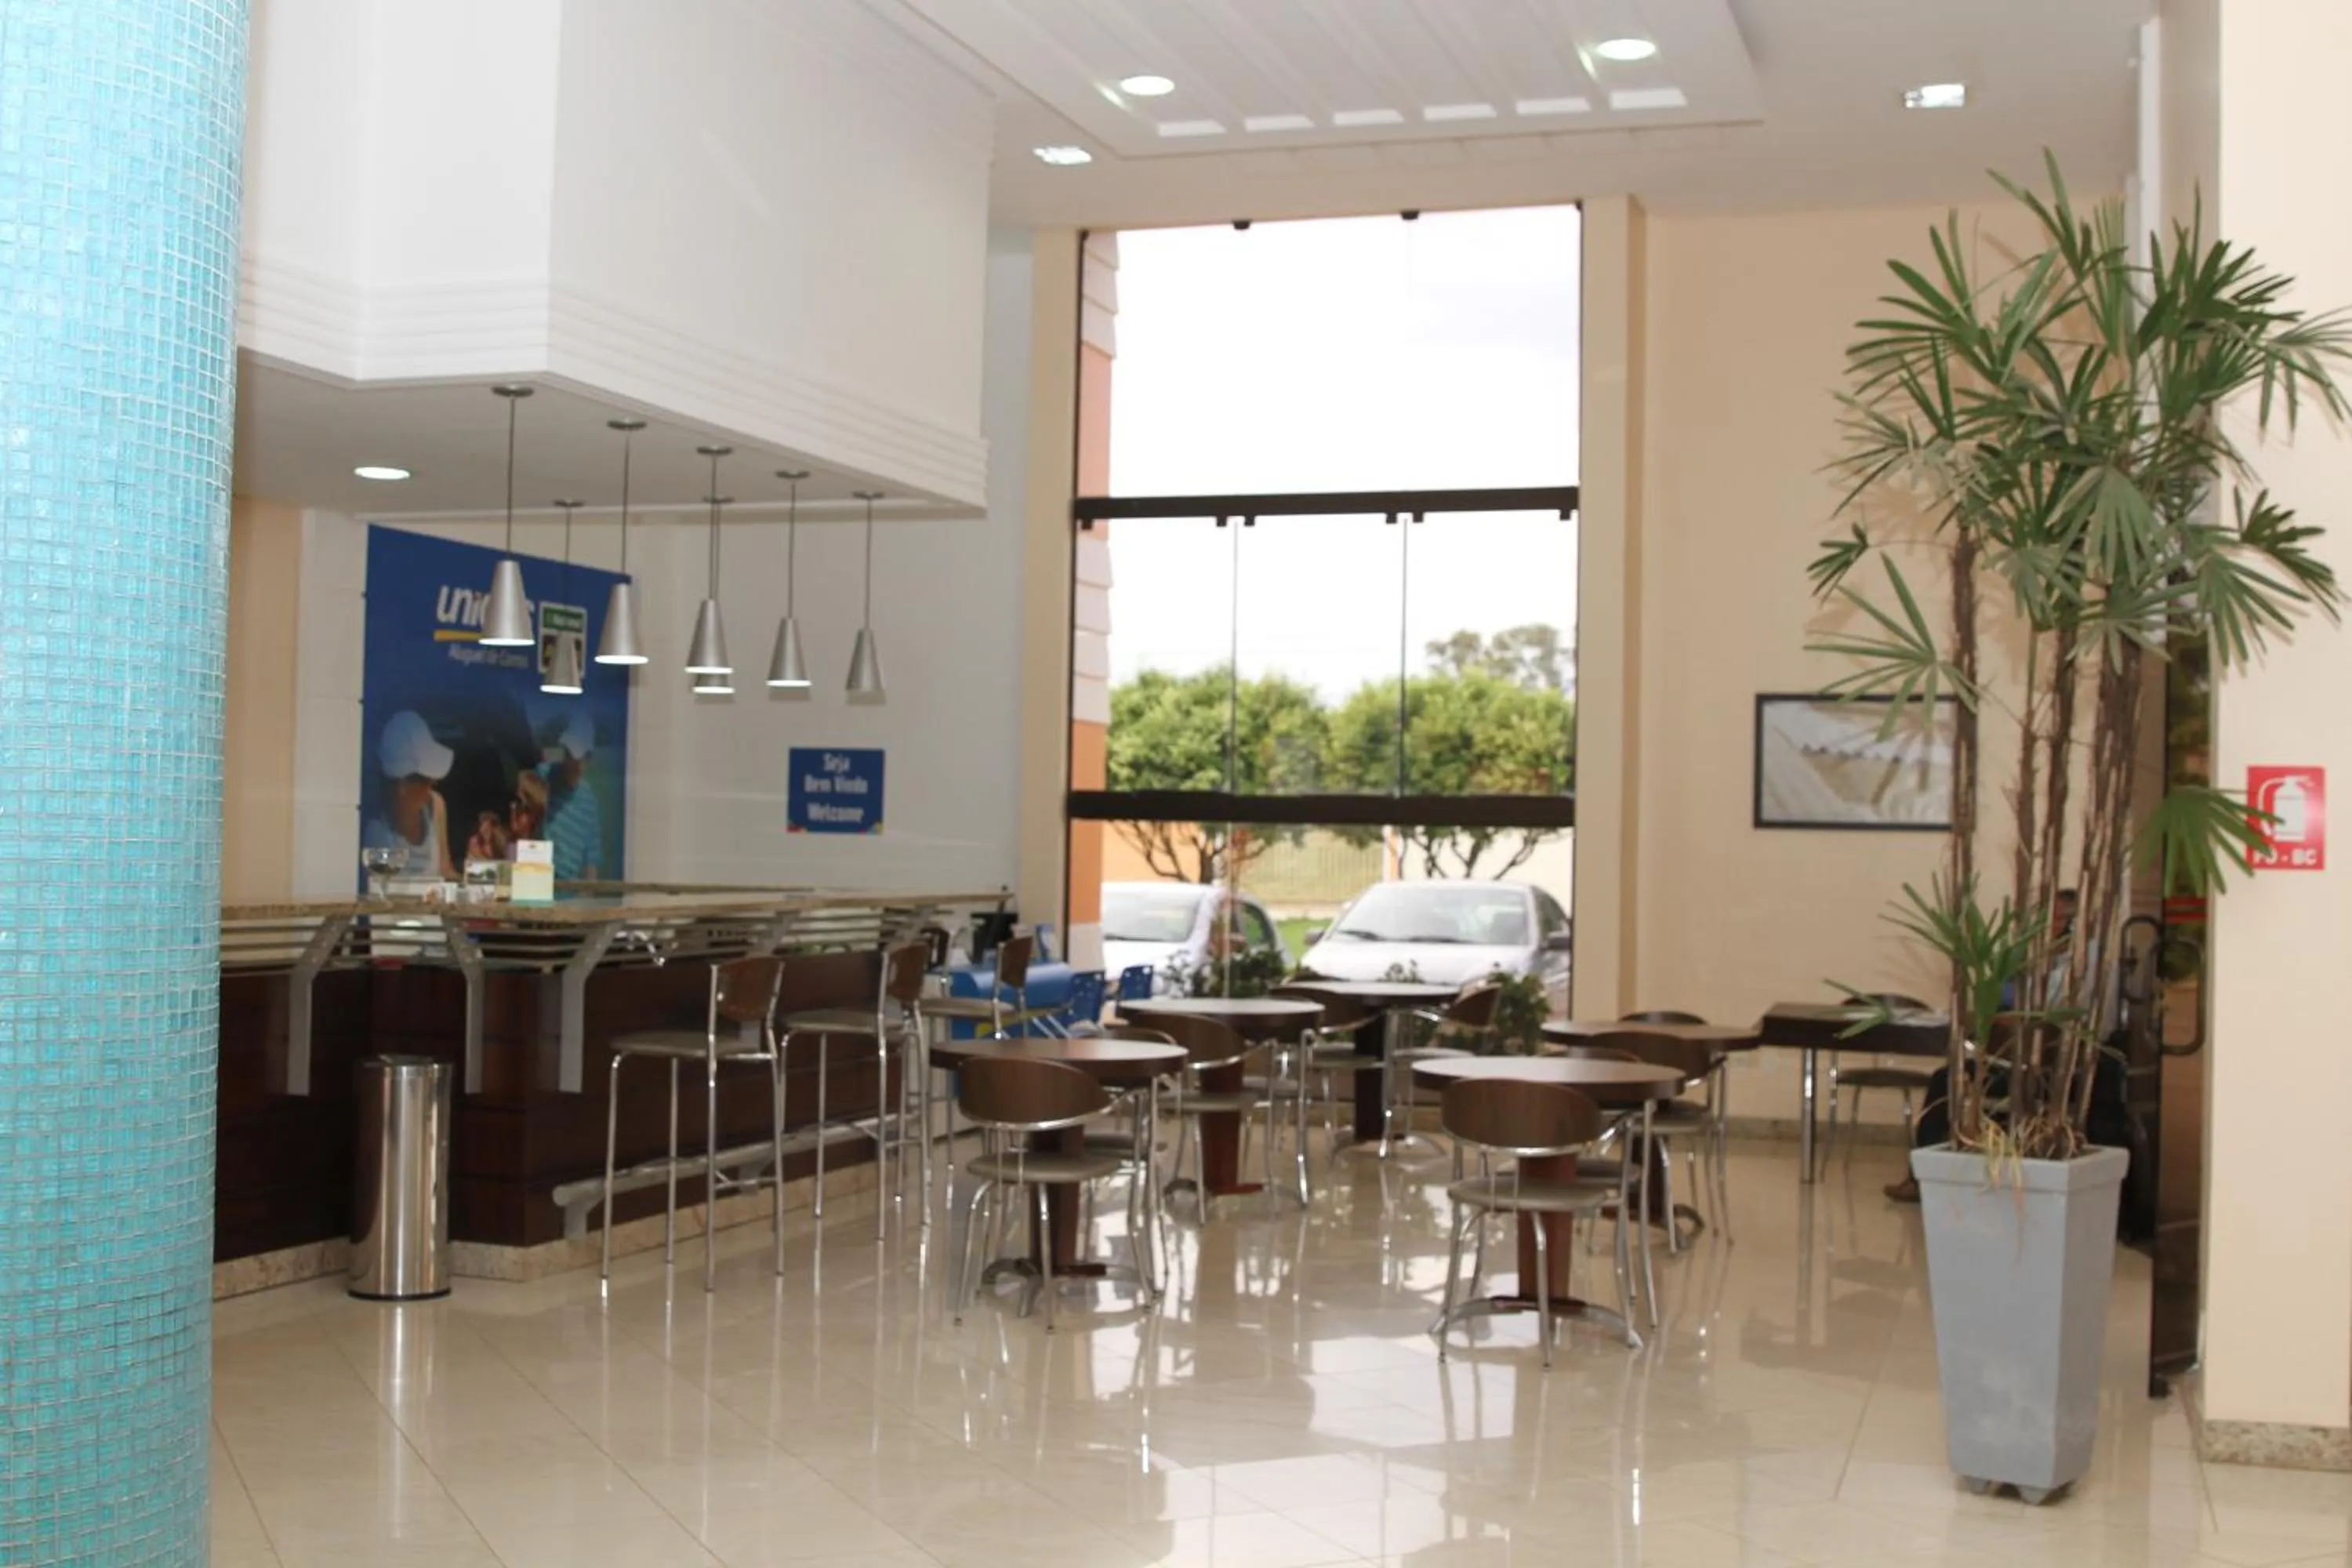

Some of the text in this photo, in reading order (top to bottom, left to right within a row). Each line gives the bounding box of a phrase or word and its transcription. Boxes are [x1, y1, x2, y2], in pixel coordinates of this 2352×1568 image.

[823, 753, 851, 774] Seja
[804, 774, 831, 793] Bem
[807, 802, 864, 823] Welcome
